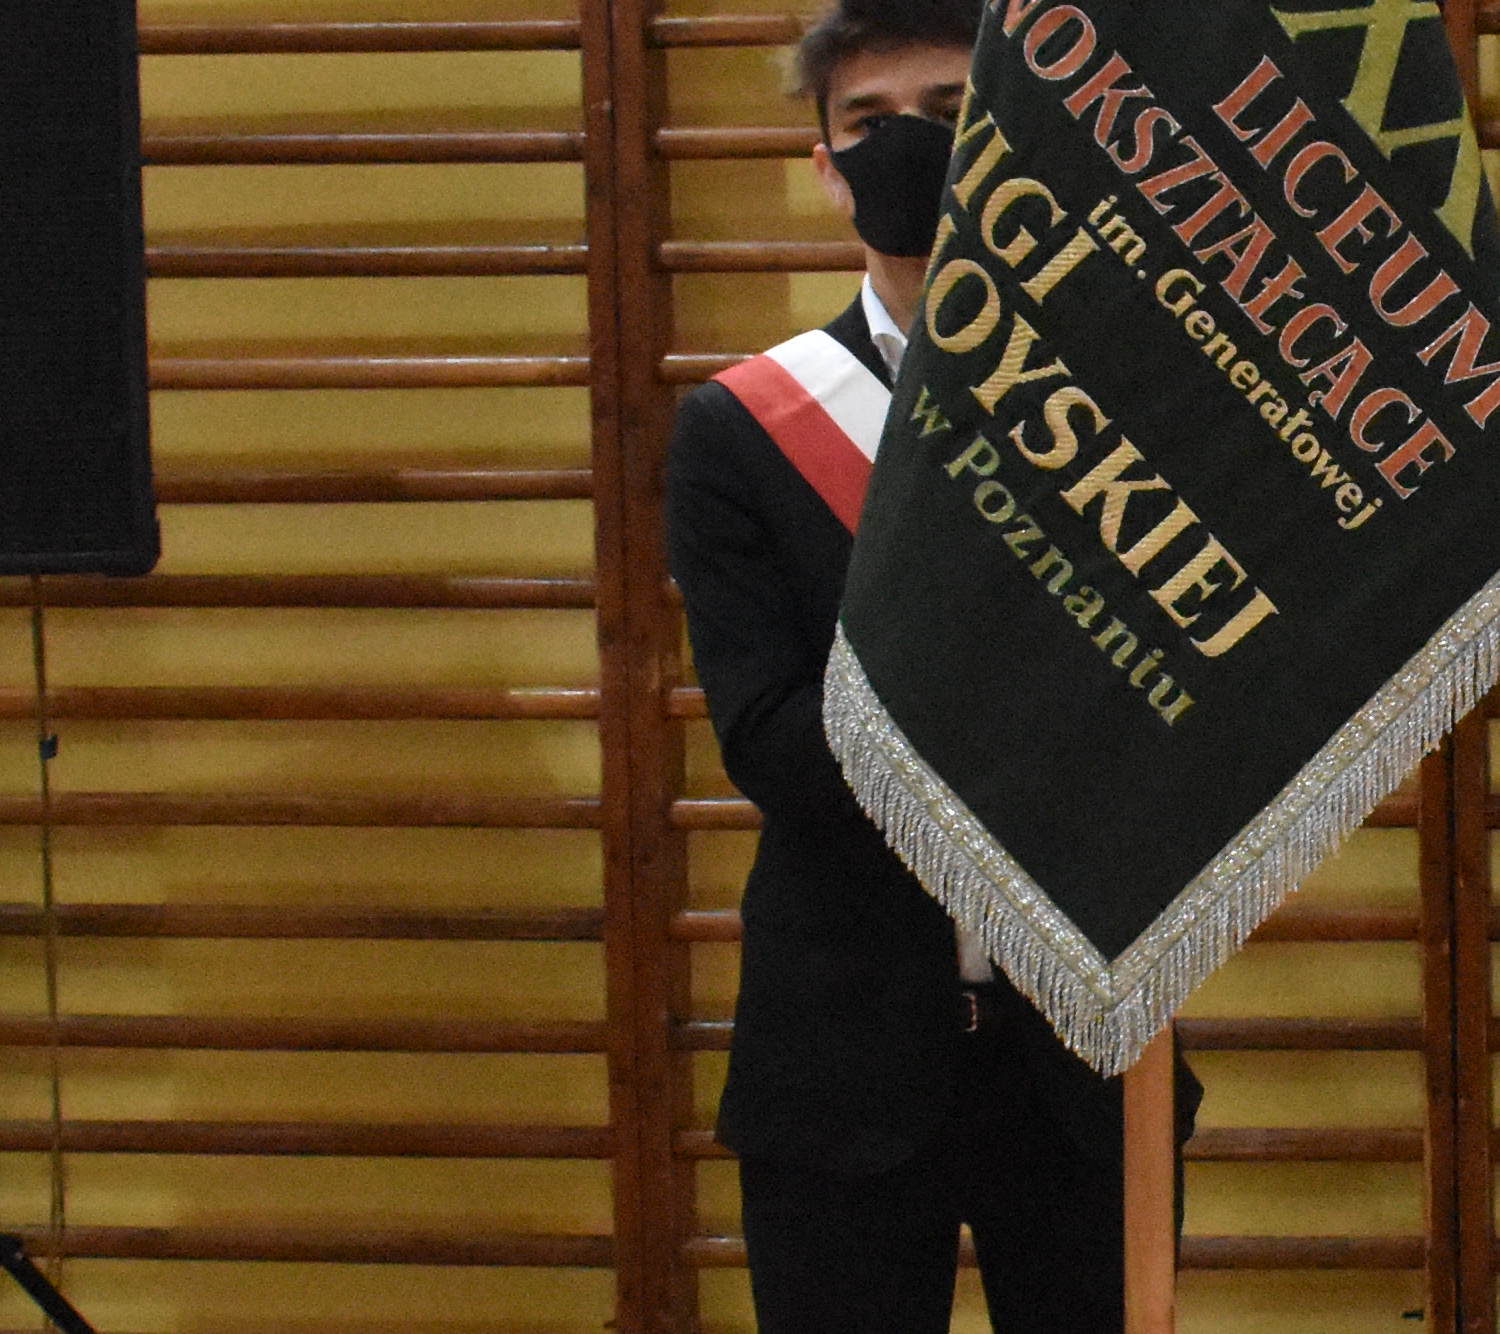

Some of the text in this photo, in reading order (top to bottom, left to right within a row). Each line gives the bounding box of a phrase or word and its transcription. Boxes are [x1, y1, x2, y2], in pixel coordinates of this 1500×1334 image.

[1086, 194, 1384, 531] im. Generałowej
[909, 384, 1197, 729] w Poznaniu
